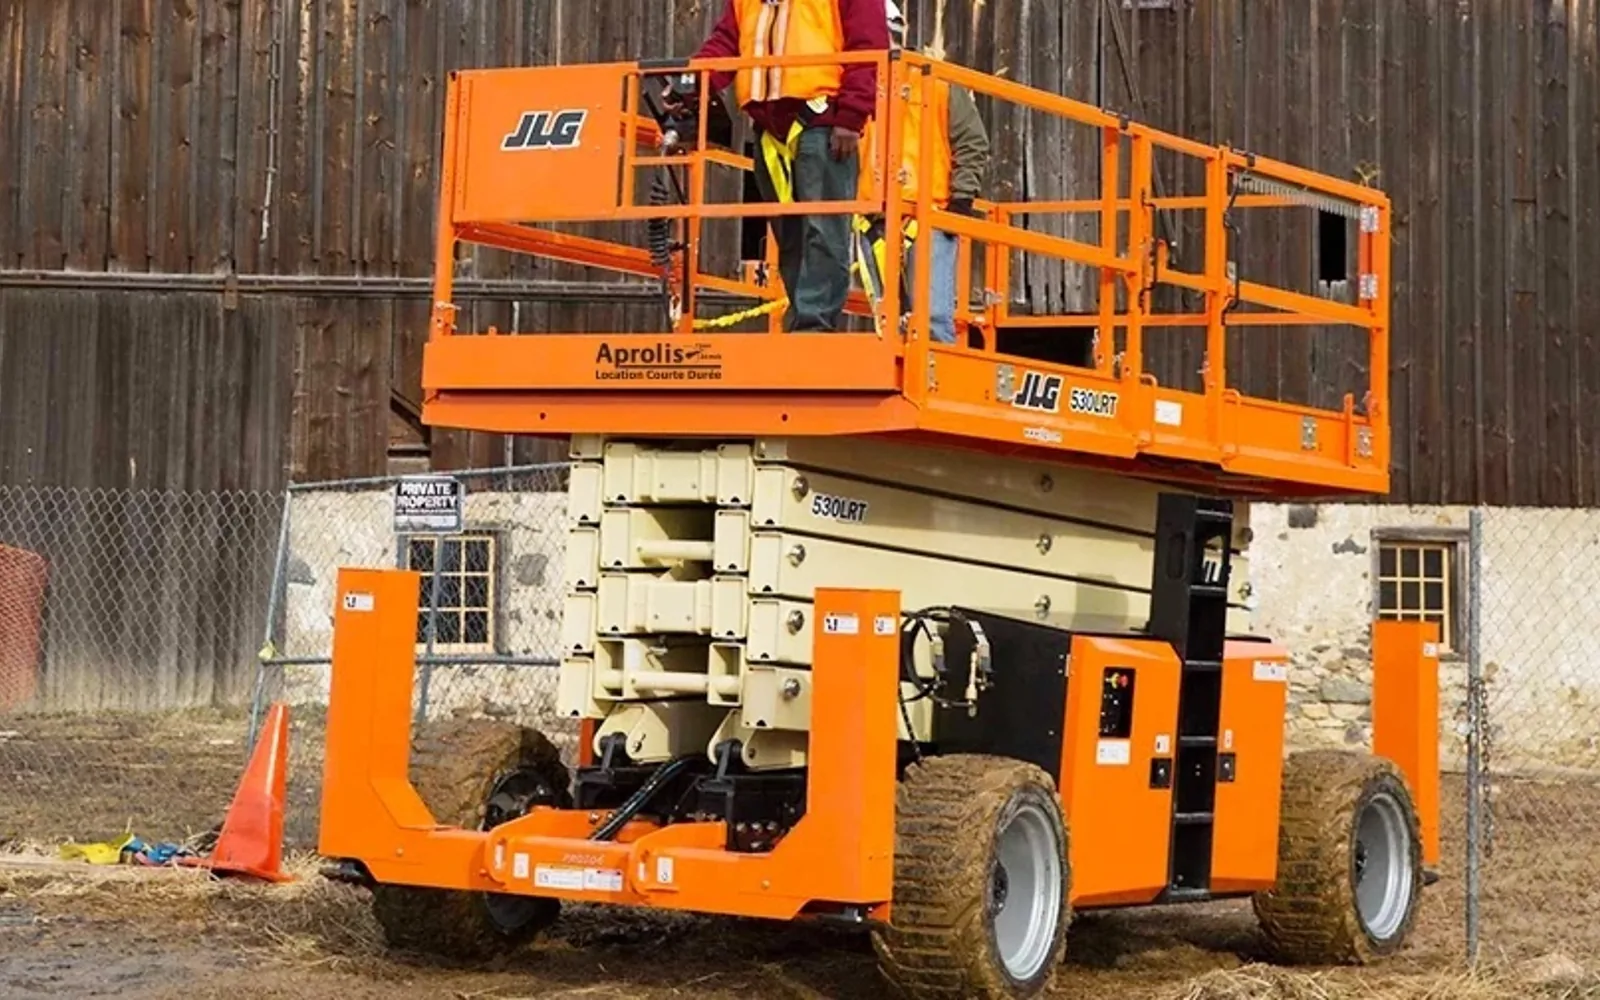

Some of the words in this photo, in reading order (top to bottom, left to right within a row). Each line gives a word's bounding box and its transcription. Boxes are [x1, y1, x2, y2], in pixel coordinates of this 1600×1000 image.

[501, 109, 586, 149] JLG
[595, 342, 684, 369] Aprolis
[595, 369, 644, 380] Location
[646, 370, 685, 380] Courte
[687, 368, 722, 380] Durée
[1013, 371, 1062, 412] JLG
[1070, 388, 1118, 416] 530LRT
[401, 482, 452, 495] PRIVATE
[397, 495, 457, 509] PROPERTY
[812, 495, 867, 521] 530LRT
